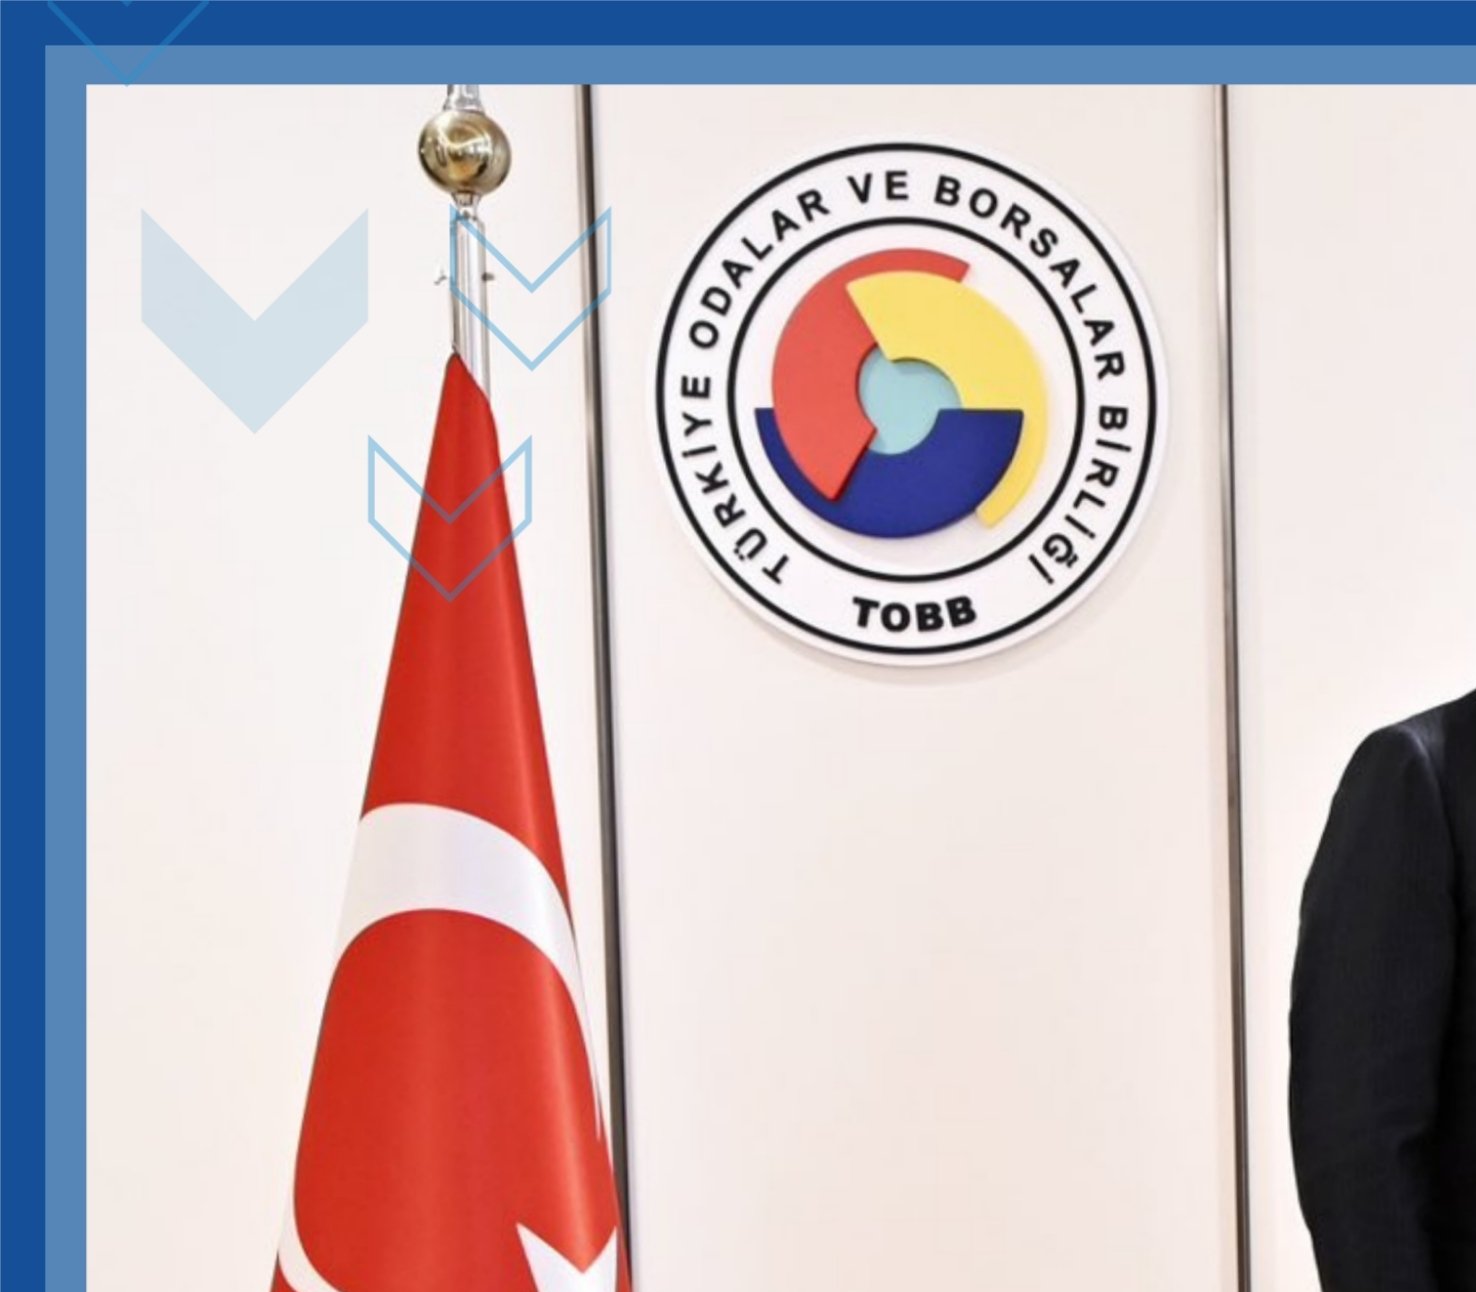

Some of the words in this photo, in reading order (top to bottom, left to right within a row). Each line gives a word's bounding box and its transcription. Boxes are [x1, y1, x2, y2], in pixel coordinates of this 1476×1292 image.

[688, 189, 830, 349] ODALAR
[848, 171, 908, 204] VE
[934, 174, 1125, 380] BORSALAR
[681, 375, 789, 584] TÜRKİYE
[1028, 406, 1131, 584] BİRLİĞİ
[853, 596, 976, 632] TOBB
